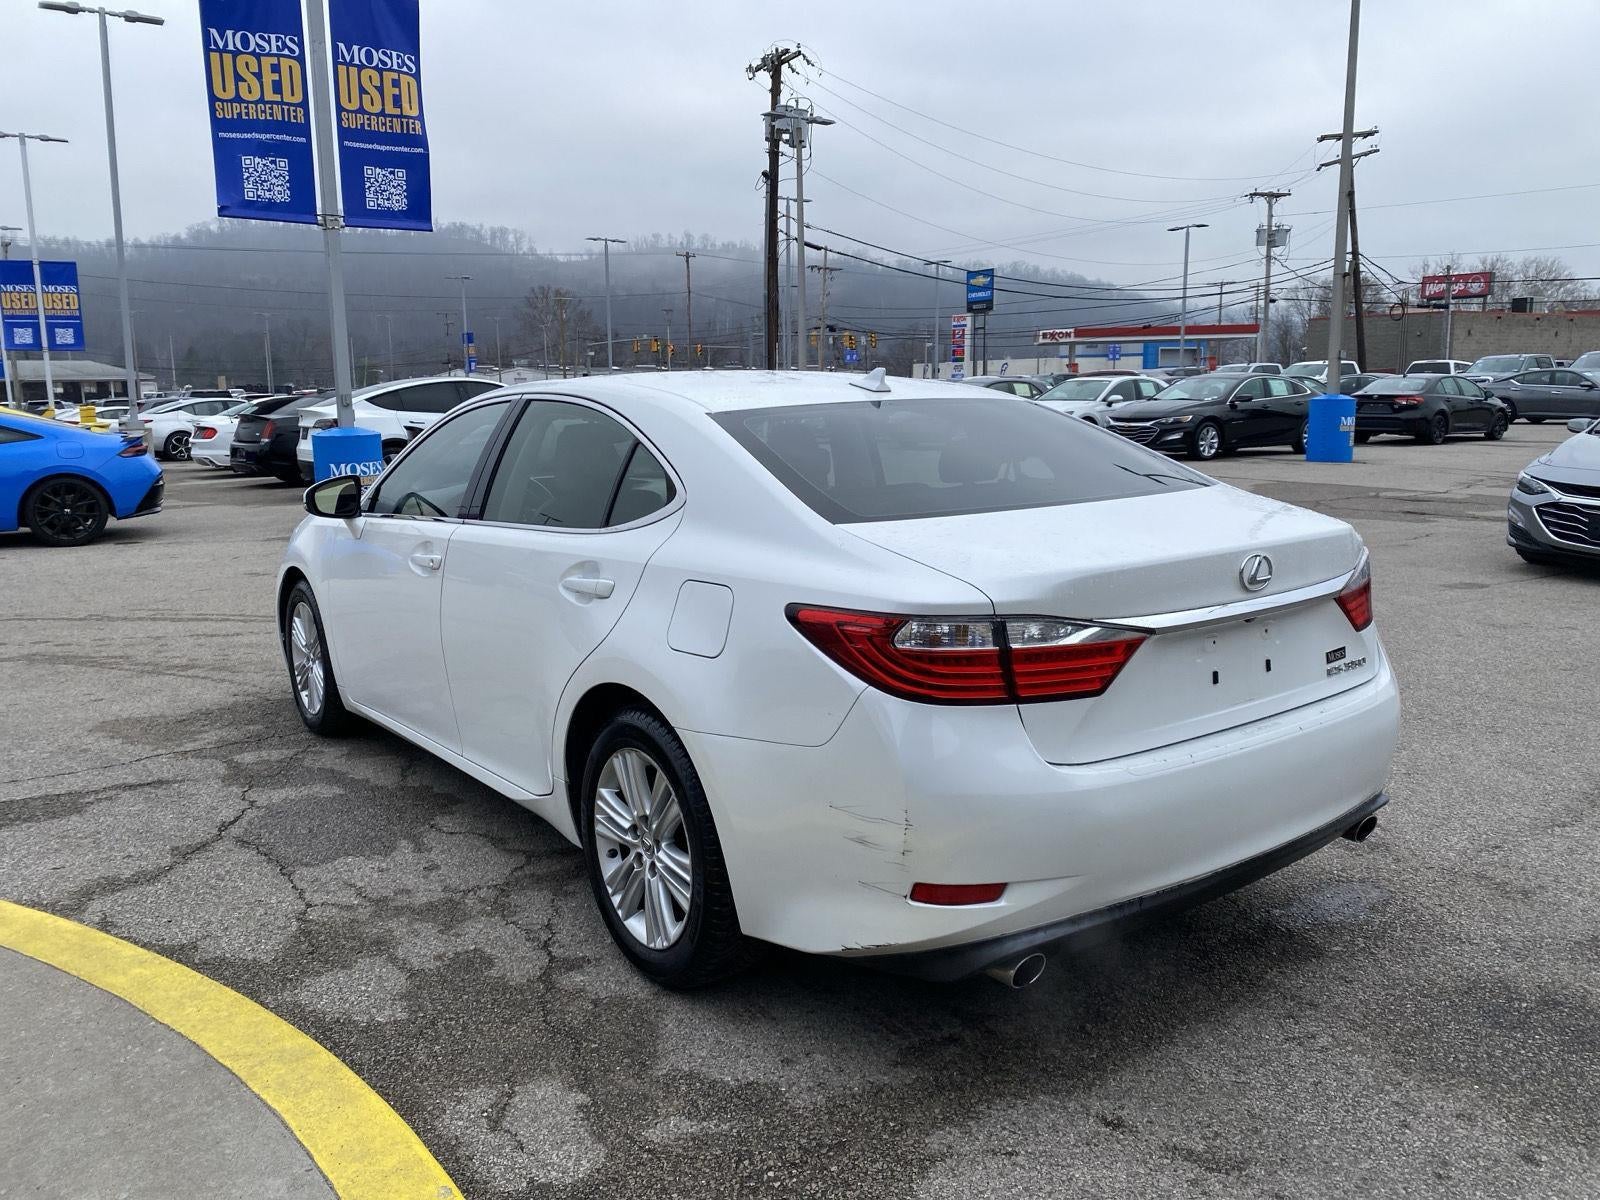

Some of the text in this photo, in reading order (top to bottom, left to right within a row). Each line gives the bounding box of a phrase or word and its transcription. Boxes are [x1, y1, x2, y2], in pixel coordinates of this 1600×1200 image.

[207, 27, 300, 57] MOSES
[336, 41, 417, 74] MOSES
[209, 52, 303, 104] USED
[337, 64, 420, 117] USED
[215, 101, 305, 124] SUPERCENTER
[341, 111, 423, 136] SUPERCENTER
[218, 131, 307, 143] mosesusedsupercenter.com
[343, 139, 425, 154] mosesusedsupercenter.com
[0, 284, 35, 292] MOSES
[967, 290, 992, 299] CHEVROLET
[1425, 277, 1465, 295] Weny's
[1, 292, 37, 309] USED
[43, 293, 78, 309] USED
[1042, 330, 1072, 342] EXXON
